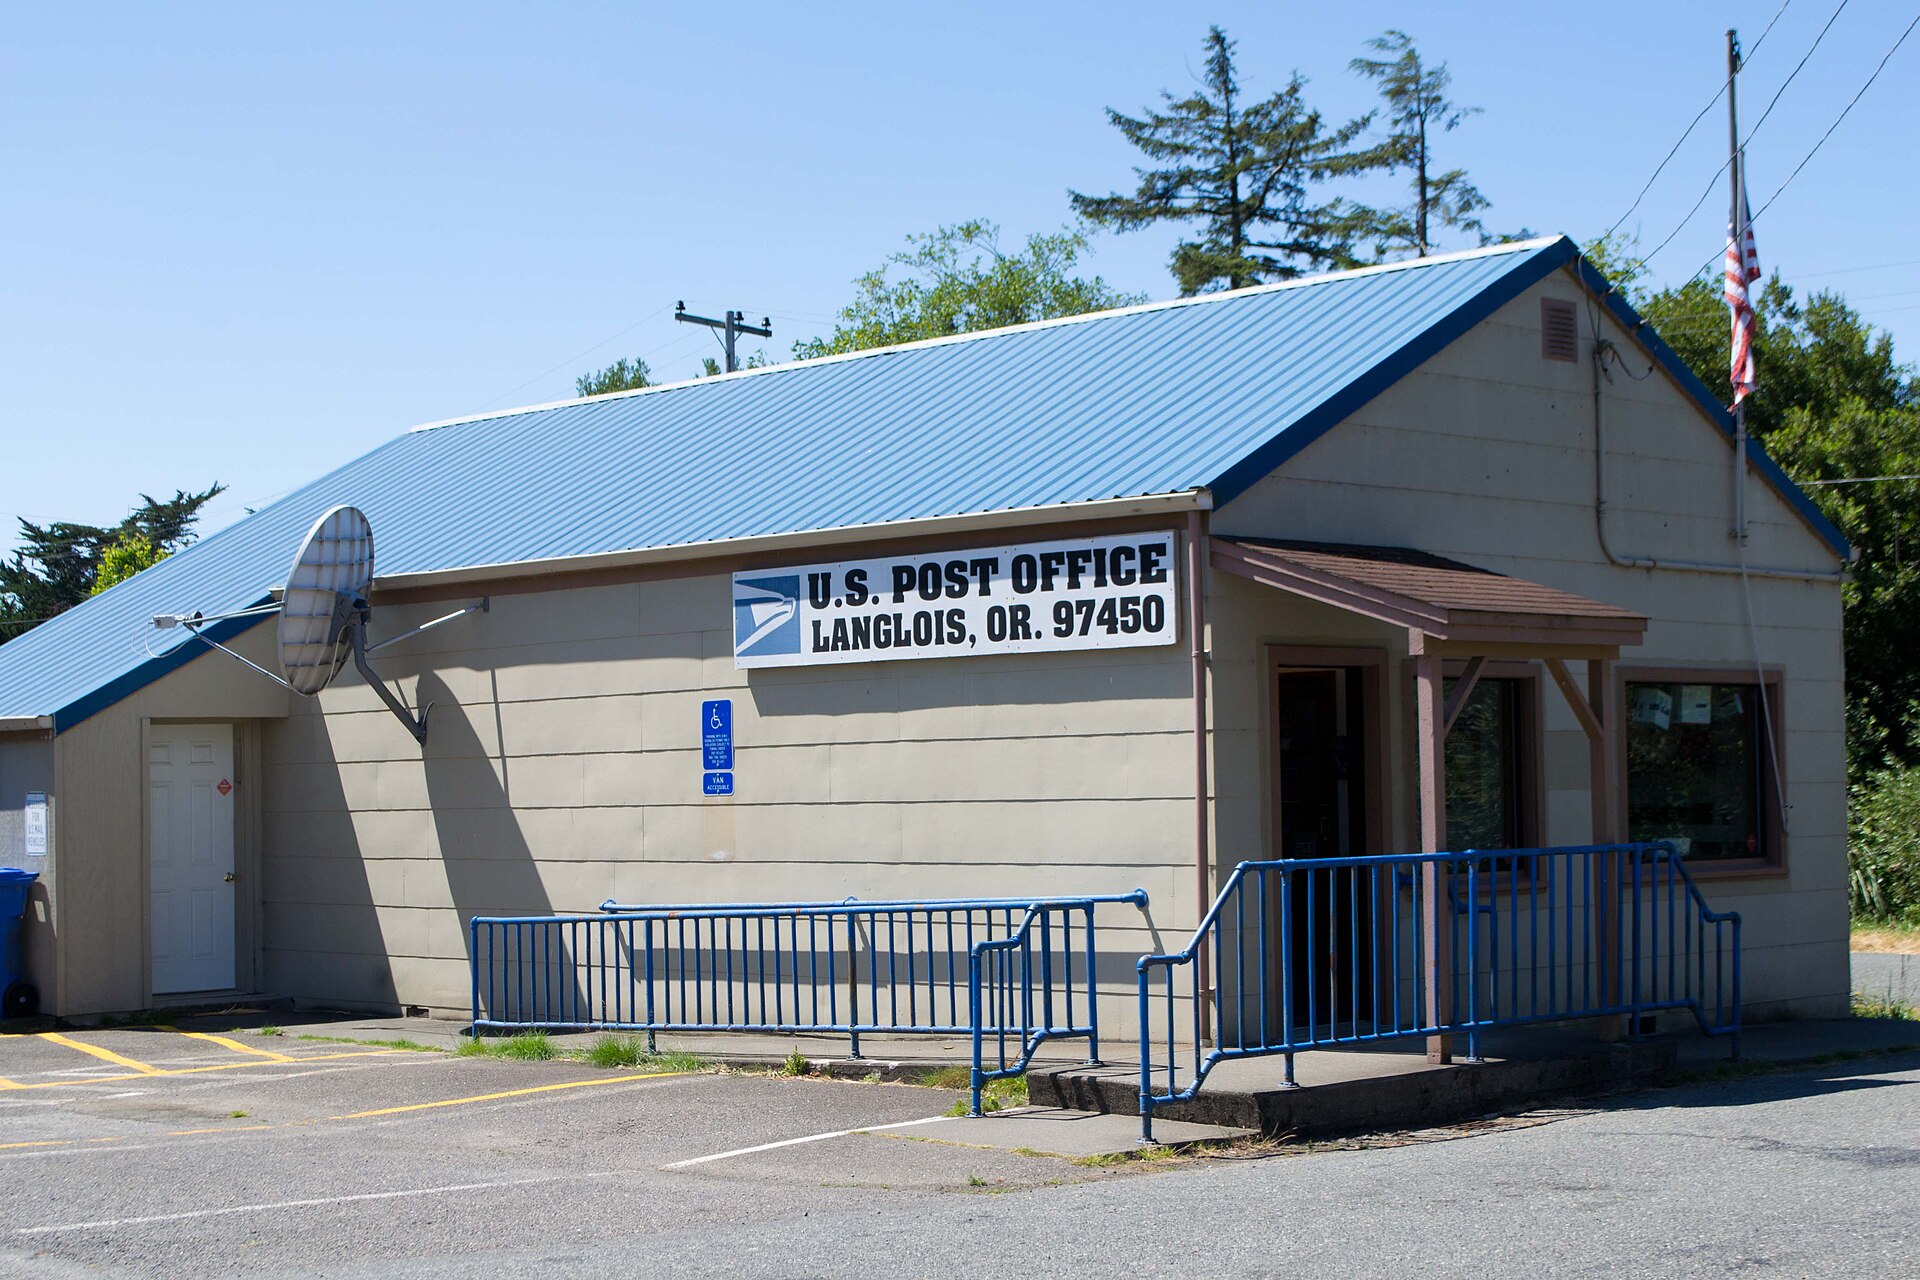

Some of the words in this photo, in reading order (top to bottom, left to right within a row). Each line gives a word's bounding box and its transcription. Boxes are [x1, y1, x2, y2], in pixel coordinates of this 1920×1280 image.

[808, 568, 880, 610] U.S.
[892, 557, 999, 604] POST
[1011, 542, 1168, 595] OFFICE
[812, 608, 977, 653] LANGLOIS,
[987, 604, 1043, 642] OR.
[1053, 594, 1165, 638] 97450
[712, 776, 724, 784] VAN
